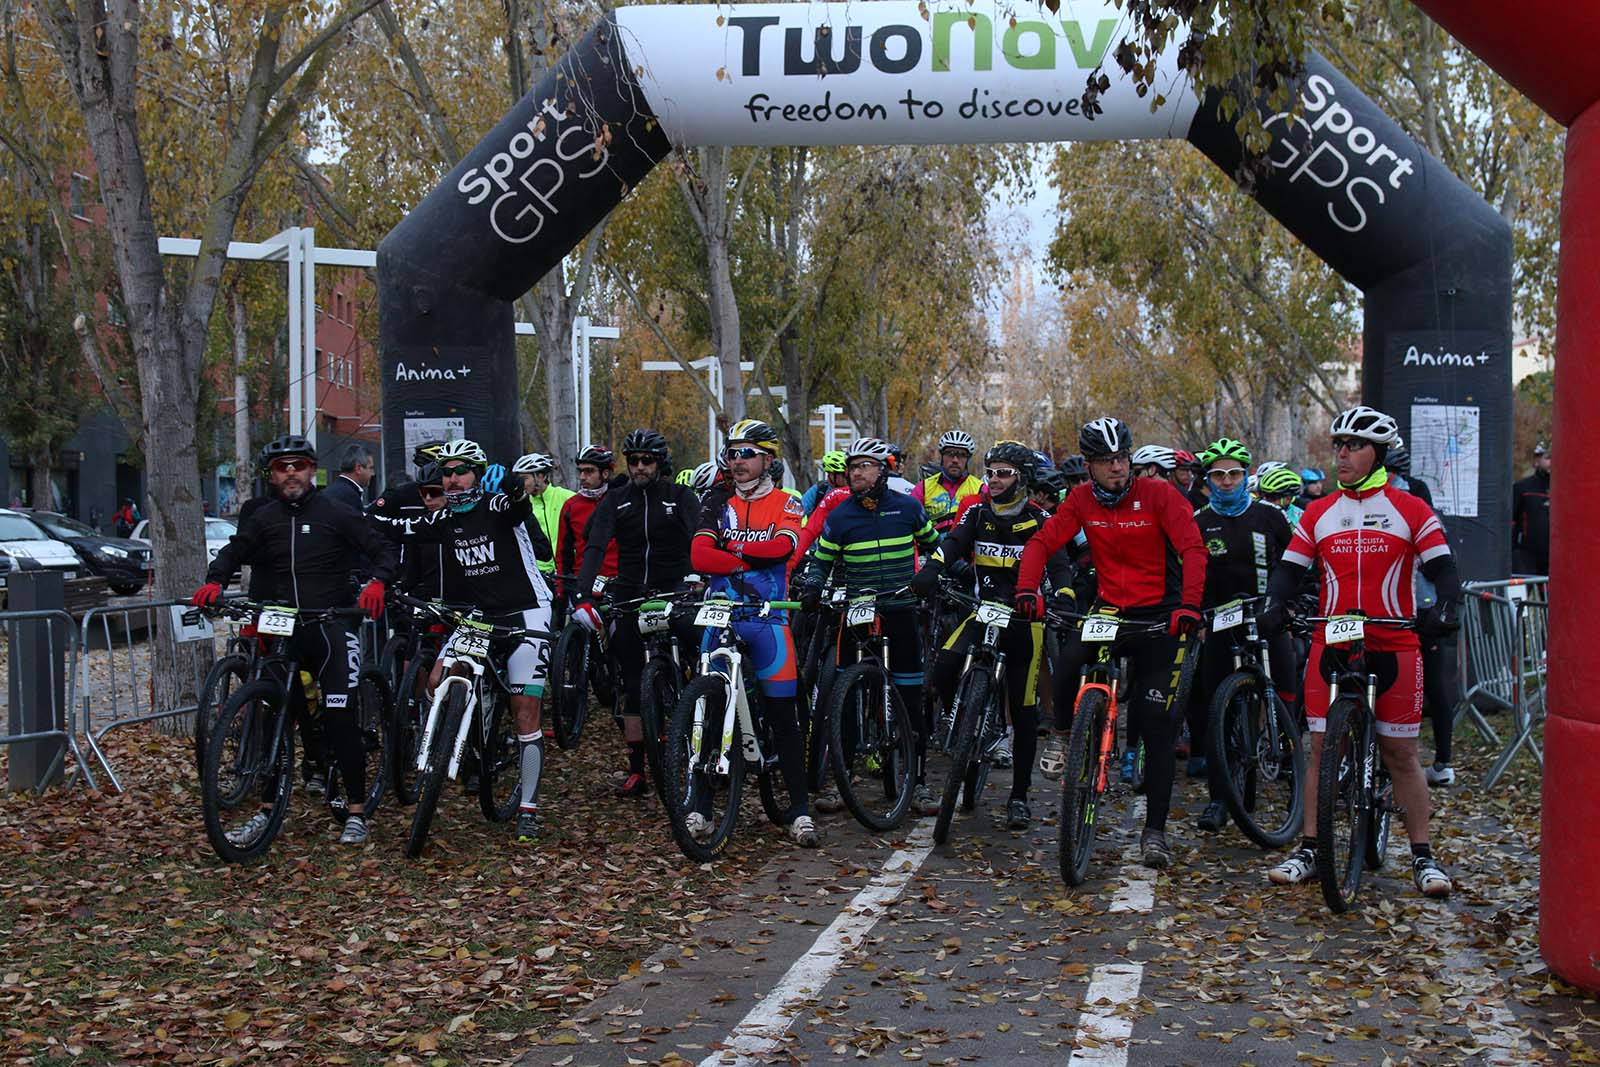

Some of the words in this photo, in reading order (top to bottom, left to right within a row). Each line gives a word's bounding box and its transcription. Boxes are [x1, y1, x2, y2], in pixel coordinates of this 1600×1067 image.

[744, 91, 888, 123] freedom
[899, 90, 944, 120] to
[959, 88, 1100, 120] discove
[1257, 112, 1385, 232] GPS
[489, 125, 609, 244] GPS
[1331, 545, 1352, 553] SANT
[265, 616, 288, 627] 223
[702, 611, 724, 621] 149
[1222, 615, 1235, 624] 90
[1089, 625, 1112, 634] 187
[1332, 622, 1357, 635] 202
